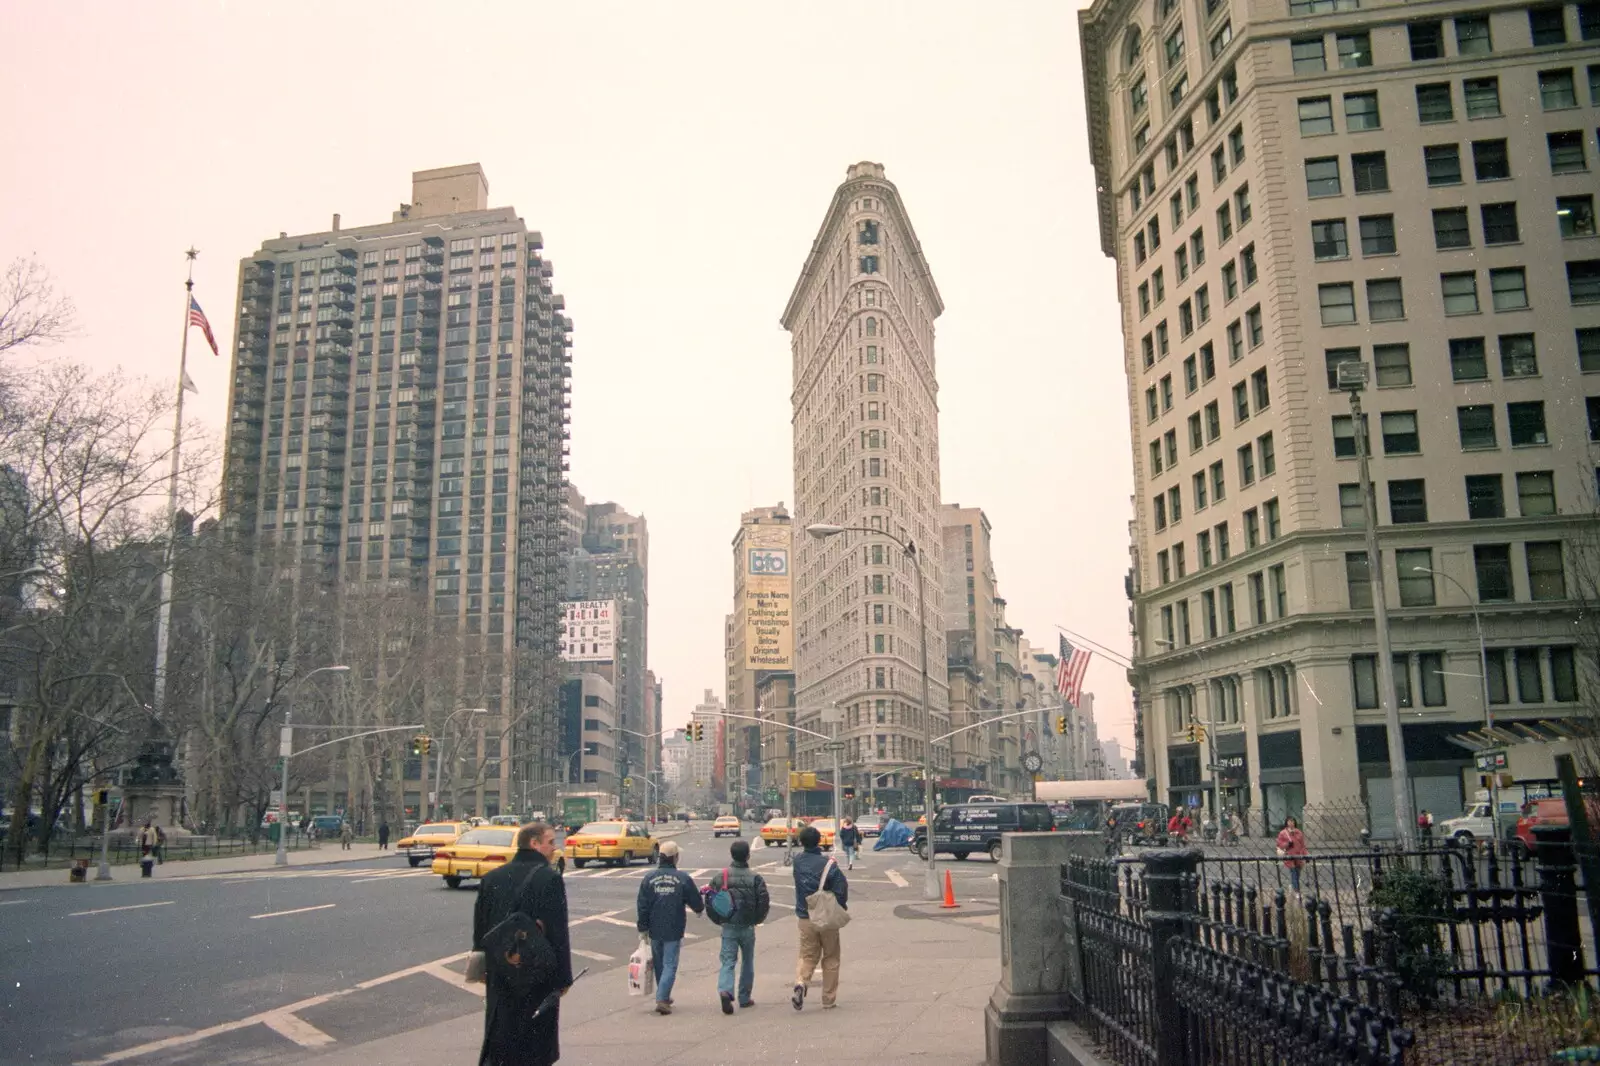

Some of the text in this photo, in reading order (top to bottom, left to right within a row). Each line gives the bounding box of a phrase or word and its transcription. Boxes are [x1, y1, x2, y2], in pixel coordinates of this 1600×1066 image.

[752, 552, 784, 571] bfo
[746, 590, 790, 599] Famous Name
[757, 599, 778, 608] Men's
[747, 608, 788, 617] Clothing and
[747, 617, 790, 627] Furnishings
[756, 627, 780, 636] Usually
[758, 636, 778, 645] Below
[753, 646, 780, 655] Original
[749, 655, 788, 665] Wholesale!
